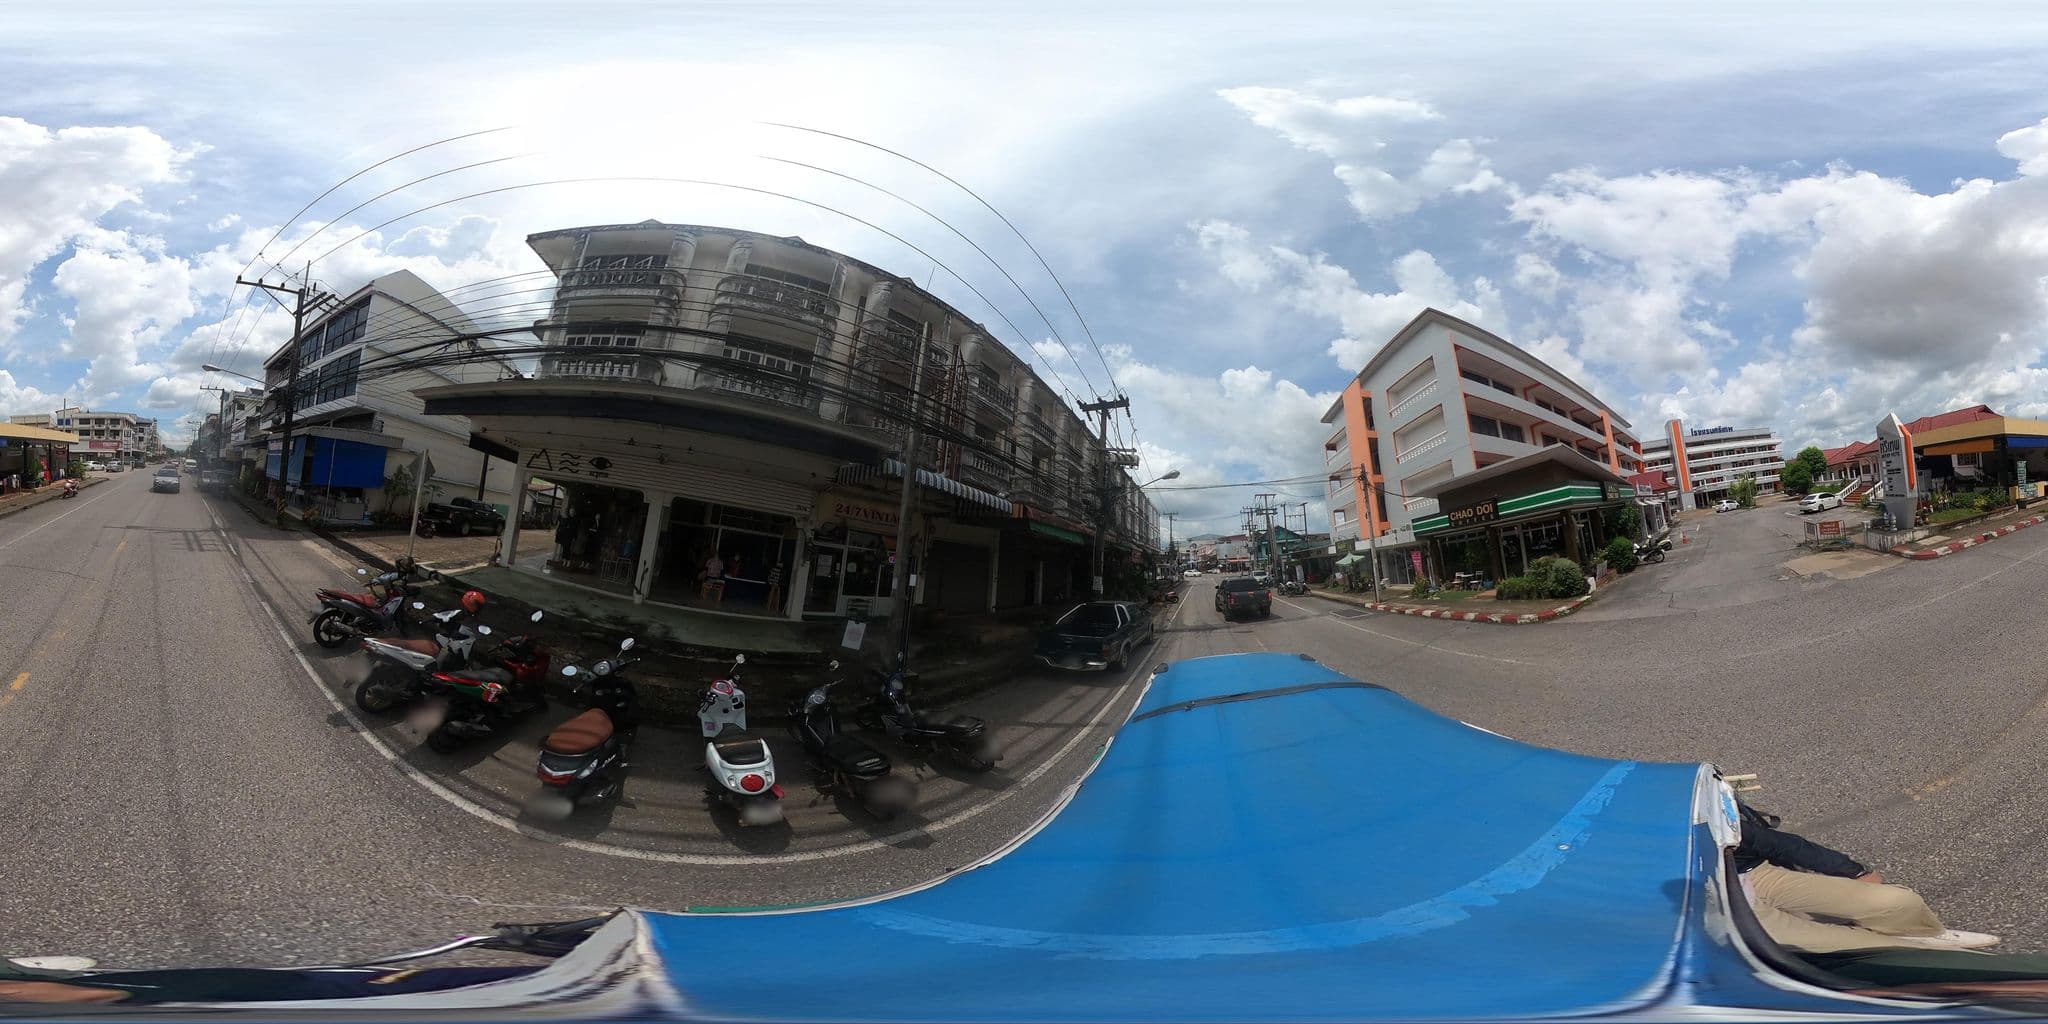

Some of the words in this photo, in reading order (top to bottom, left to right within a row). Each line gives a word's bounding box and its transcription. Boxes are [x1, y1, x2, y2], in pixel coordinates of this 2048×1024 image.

[863, 508, 900, 522] VINTA
[1450, 508, 1474, 521] CHAO
[1476, 503, 1493, 515] DOI
